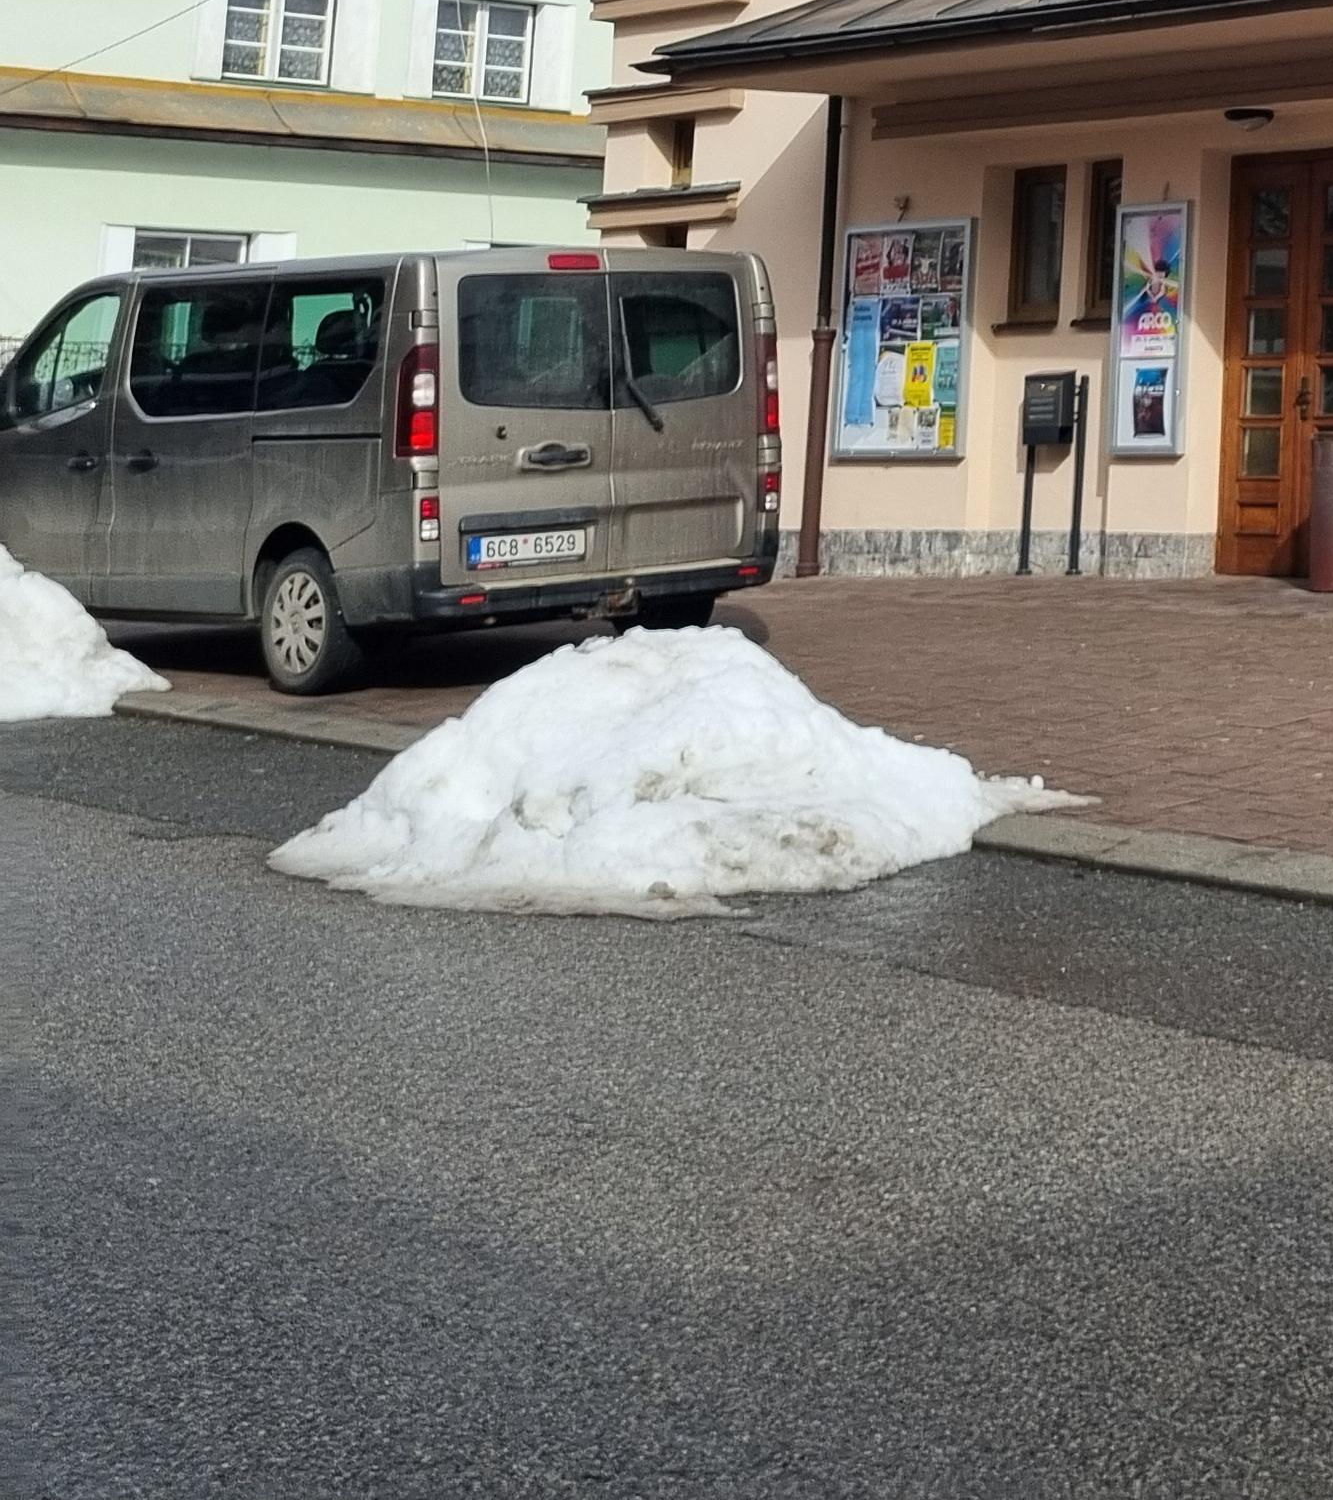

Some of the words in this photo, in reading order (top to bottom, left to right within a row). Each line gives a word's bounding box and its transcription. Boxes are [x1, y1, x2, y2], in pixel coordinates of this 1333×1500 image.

[1137, 312, 1172, 332] ARCO
[486, 538, 519, 558] 6C8
[534, 534, 577, 554] 6529
